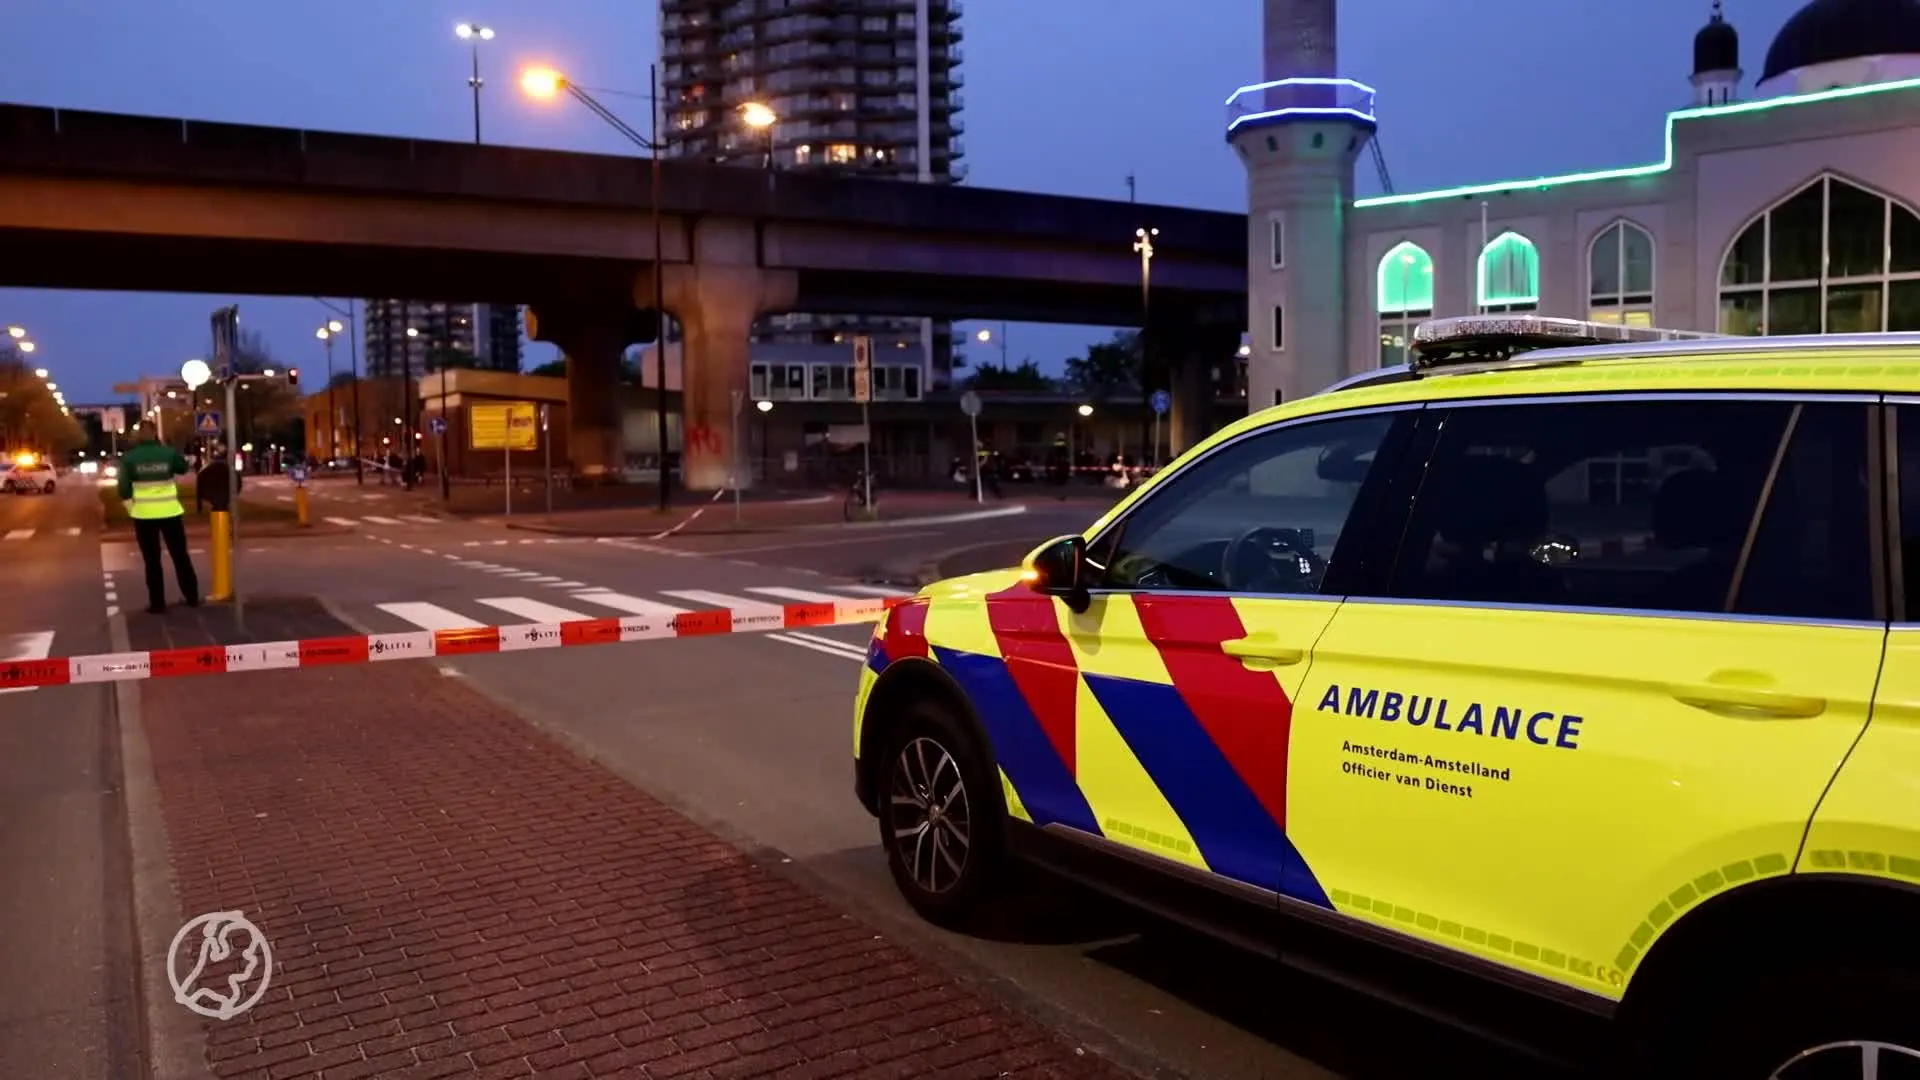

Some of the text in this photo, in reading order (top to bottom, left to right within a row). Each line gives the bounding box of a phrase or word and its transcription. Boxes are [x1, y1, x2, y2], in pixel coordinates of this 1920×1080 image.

[1318, 685, 1583, 749] AMBULANCE
[1343, 741, 1509, 781] Amsterdam-Amstelland
[1343, 762, 1472, 797] Officier van Dienst
